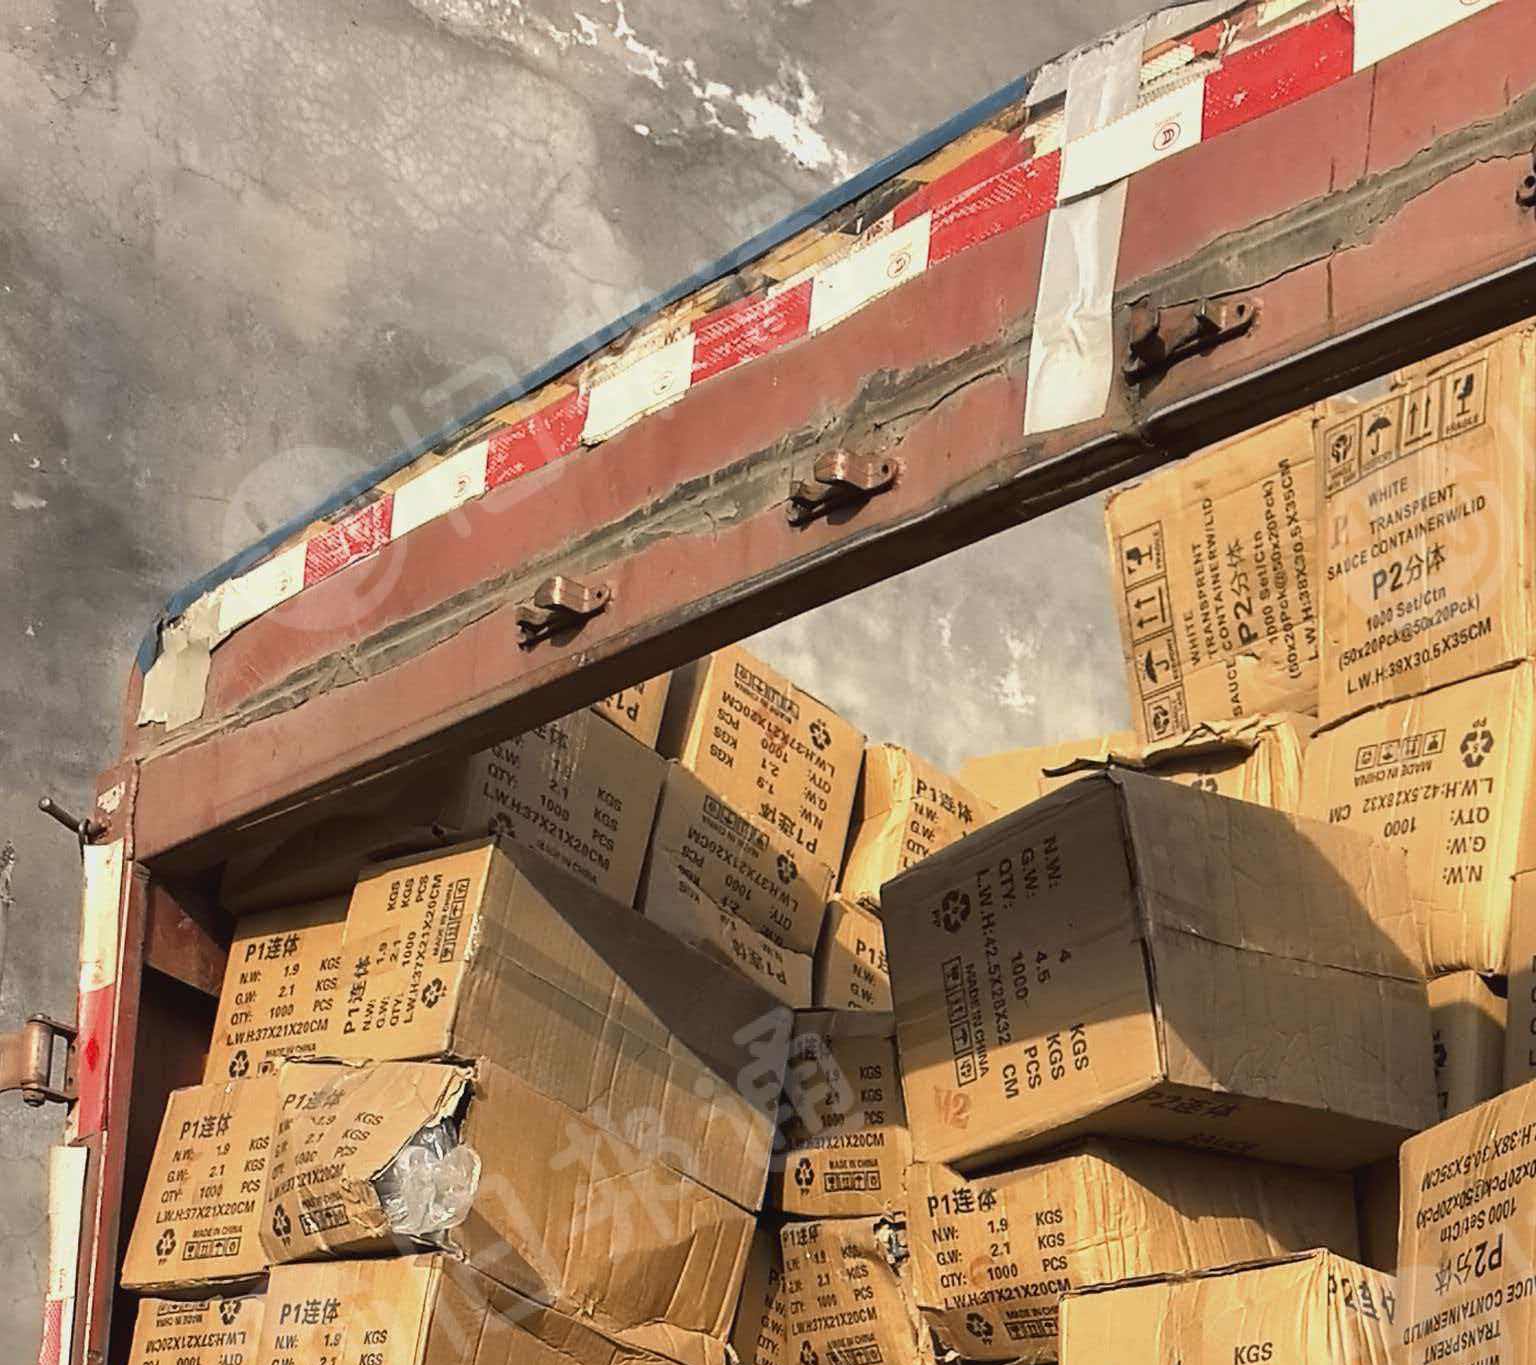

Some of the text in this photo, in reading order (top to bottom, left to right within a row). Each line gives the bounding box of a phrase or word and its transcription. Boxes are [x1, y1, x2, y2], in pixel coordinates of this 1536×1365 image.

[1367, 477, 1409, 507] WHITE
[1368, 485, 1456, 535] TRANSPRENT
[1327, 496, 1486, 580] SAUCE CONTAINERW/LID
[1371, 543, 1447, 600] P2分体
[1366, 586, 1447, 632] 1000 Set/Ctn
[1346, 618, 1493, 696] L.W.H:38X30.5X35CM
[245, 934, 301, 962] P1连体
[927, 1188, 997, 1218] P1连体
[280, 1298, 340, 1325] P1连体
